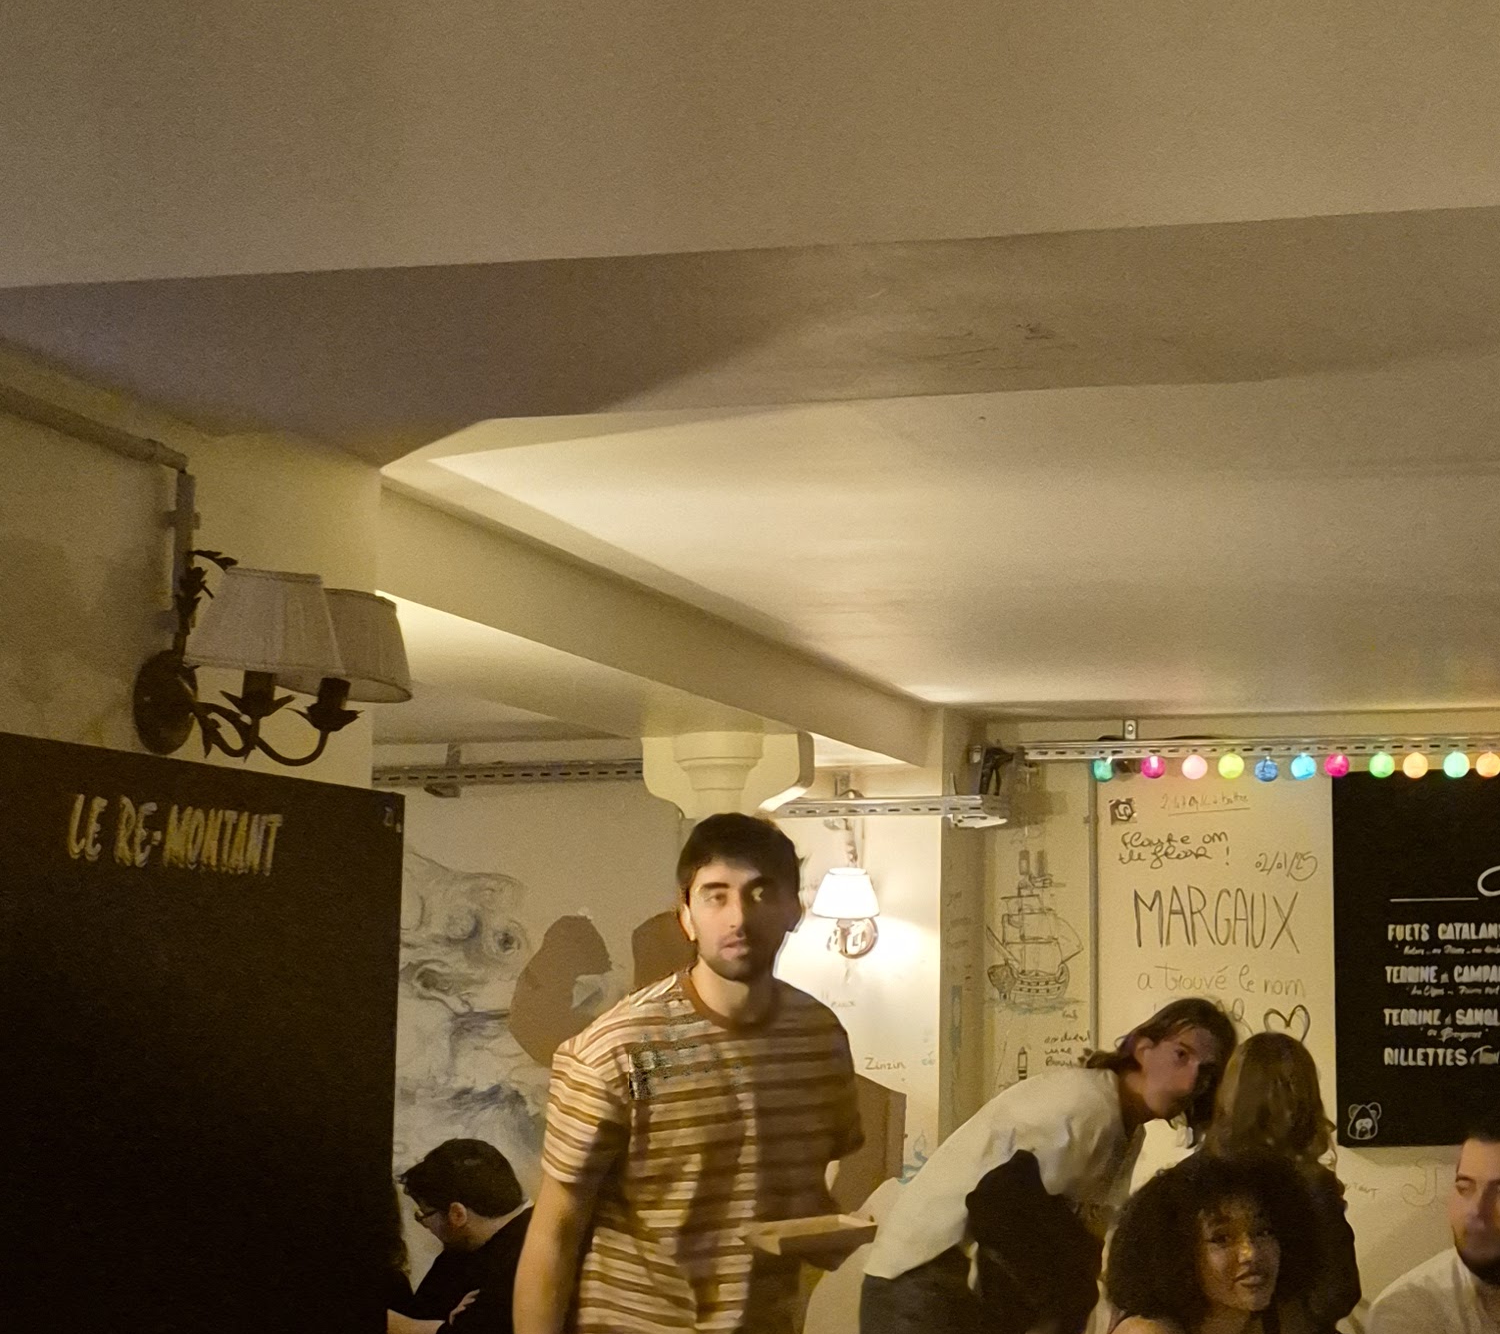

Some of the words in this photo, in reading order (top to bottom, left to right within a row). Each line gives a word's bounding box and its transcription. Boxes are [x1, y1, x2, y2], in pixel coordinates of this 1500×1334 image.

[67, 793, 108, 861] LE
[114, 794, 283, 877] RE-MONTANT
[1133, 884, 1301, 954] MARGAUX
[1386, 922, 1431, 942] FUETS
[1136, 971, 1153, 991] a
[1153, 963, 1230, 992] trouvé
[1263, 978, 1306, 998] nom
[864, 1056, 907, 1071] Zinzin
[1383, 1046, 1468, 1067] RILLETTES
